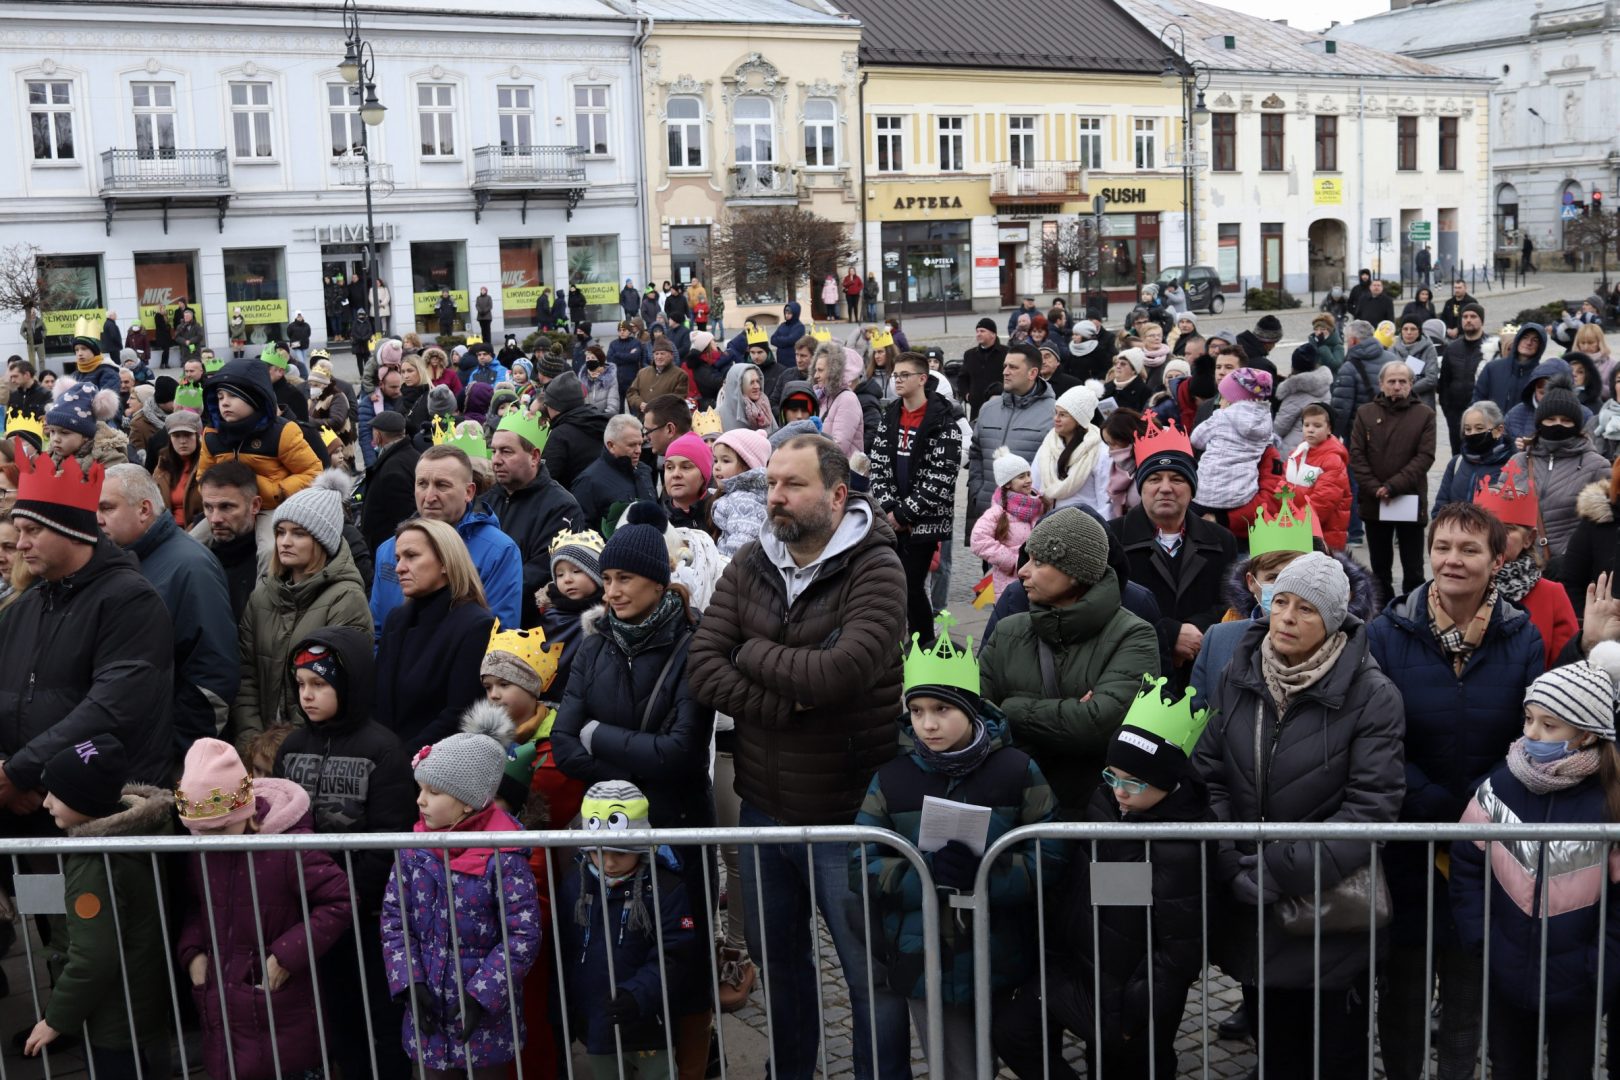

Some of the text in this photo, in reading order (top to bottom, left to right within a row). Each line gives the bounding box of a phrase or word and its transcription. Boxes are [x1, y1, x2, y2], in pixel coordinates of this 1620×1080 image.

[894, 196, 963, 209] APTEKA
[1101, 188, 1146, 203] SUSHI
[502, 270, 526, 285] NIKE
[143, 287, 173, 304] NIKE
